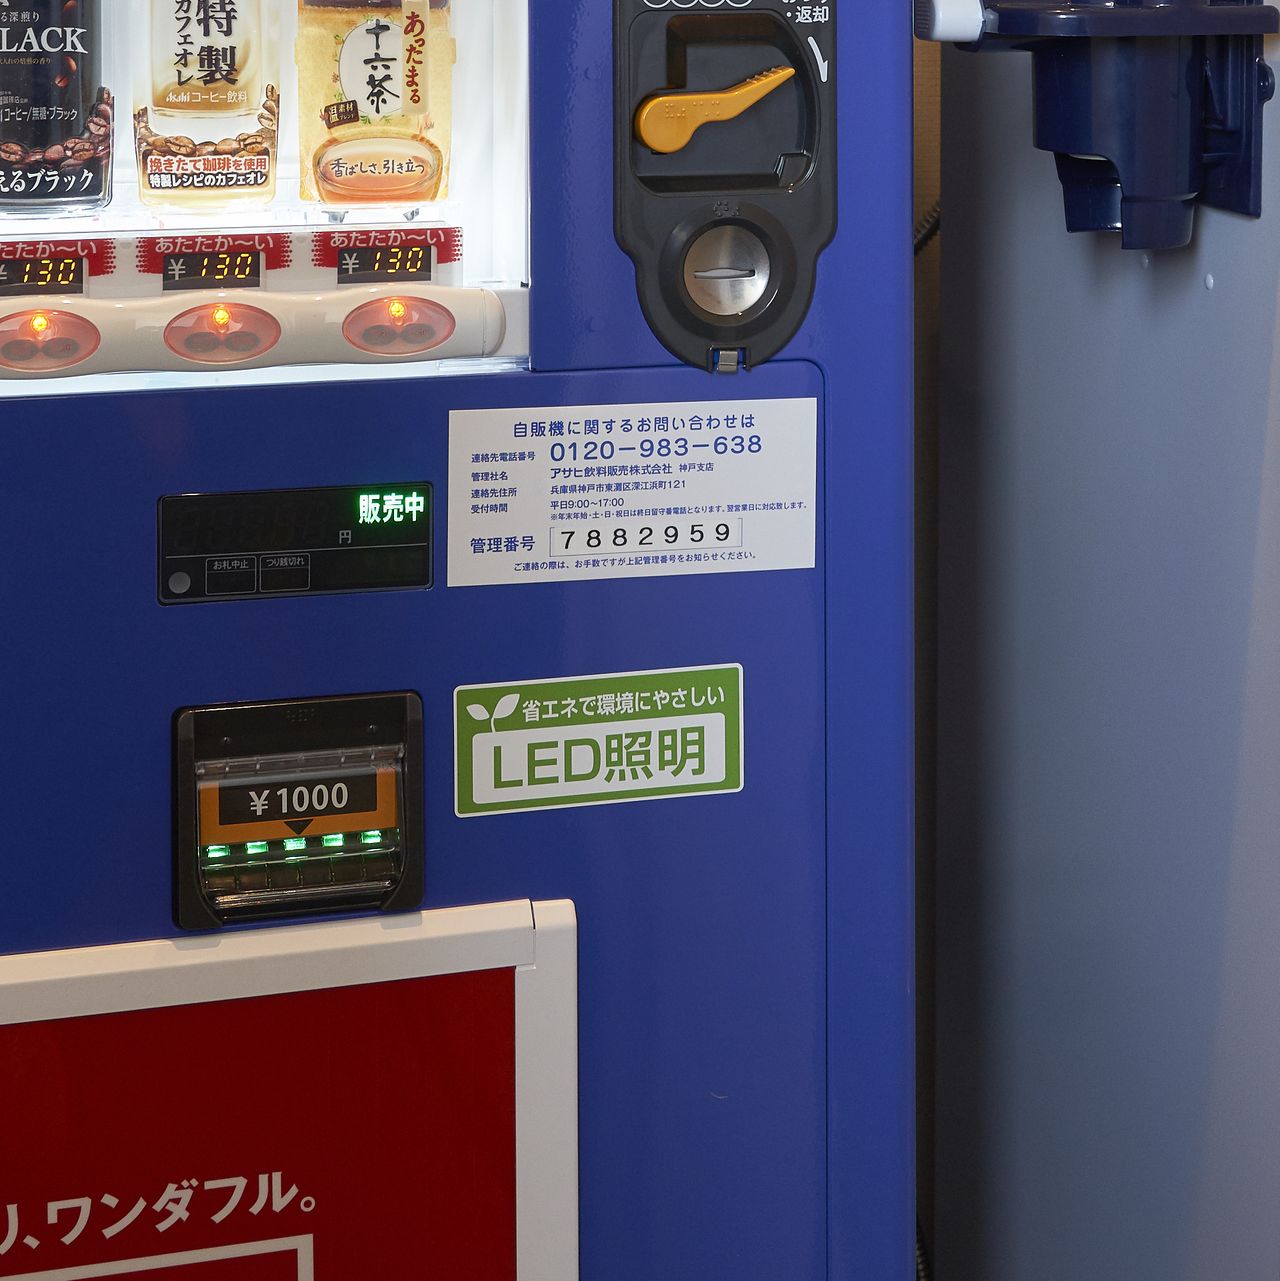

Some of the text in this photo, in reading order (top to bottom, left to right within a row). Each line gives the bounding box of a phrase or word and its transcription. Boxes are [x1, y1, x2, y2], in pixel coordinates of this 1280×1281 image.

[363, 18, 400, 115] 十六茶
[403, 11, 426, 104] あったまる
[191, 90, 248, 104] コーヒー飲料
[149, 156, 268, 173] 挽きたて珈琲を使用
[330, 158, 426, 178] 香ばしさ、引き立つ
[149, 171, 269, 189] 特製レシピのカフェオレ
[513, 413, 755, 438] 自販機に関するお問い合わせは
[471, 451, 536, 464] 連絡先電話番号
[471, 462, 715, 483] 管理社名 アサヒ飲料販売株式会社 神戸支店
[470, 487, 518, 500] 連絡先住所
[358, 492, 425, 524] 販売中
[470, 503, 508, 515] 受付時間
[338, 530, 352, 544] 円
[470, 535, 536, 554] 管理番号
[213, 556, 305, 570] お札中止 つり銭切れ
[522, 686, 726, 722] 省エネで環境にやさしい
[493, 725, 706, 790] LED照明
